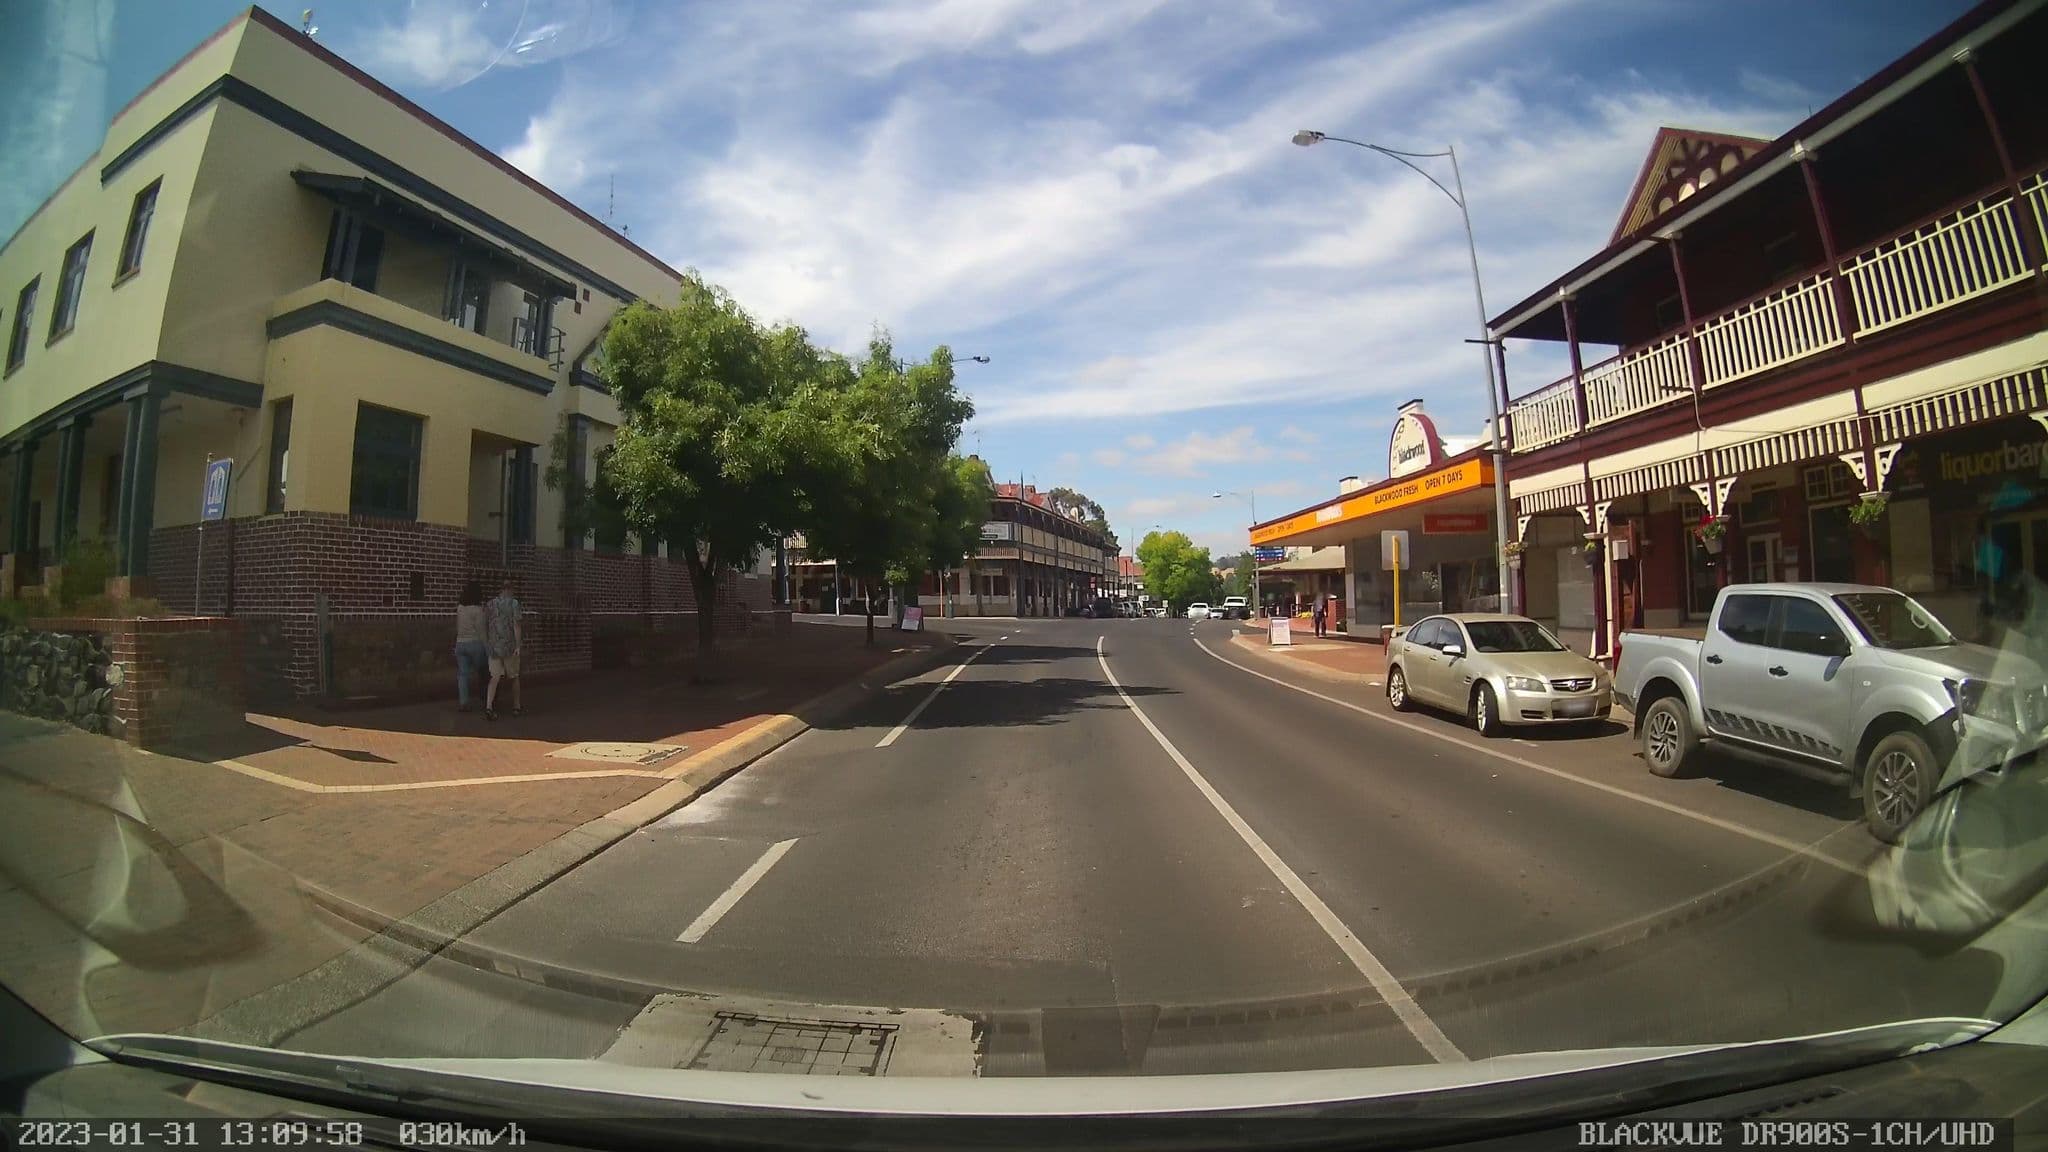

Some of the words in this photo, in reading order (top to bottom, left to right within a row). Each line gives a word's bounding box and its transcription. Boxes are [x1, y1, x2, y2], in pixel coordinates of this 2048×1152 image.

[1425, 476, 1441, 490] OPEN
[1442, 474, 1446, 486] 7
[1446, 469, 1463, 484] DAYS
[1374, 488, 1402, 504] BLACKWOOD
[1403, 483, 1419, 497] FRESH
